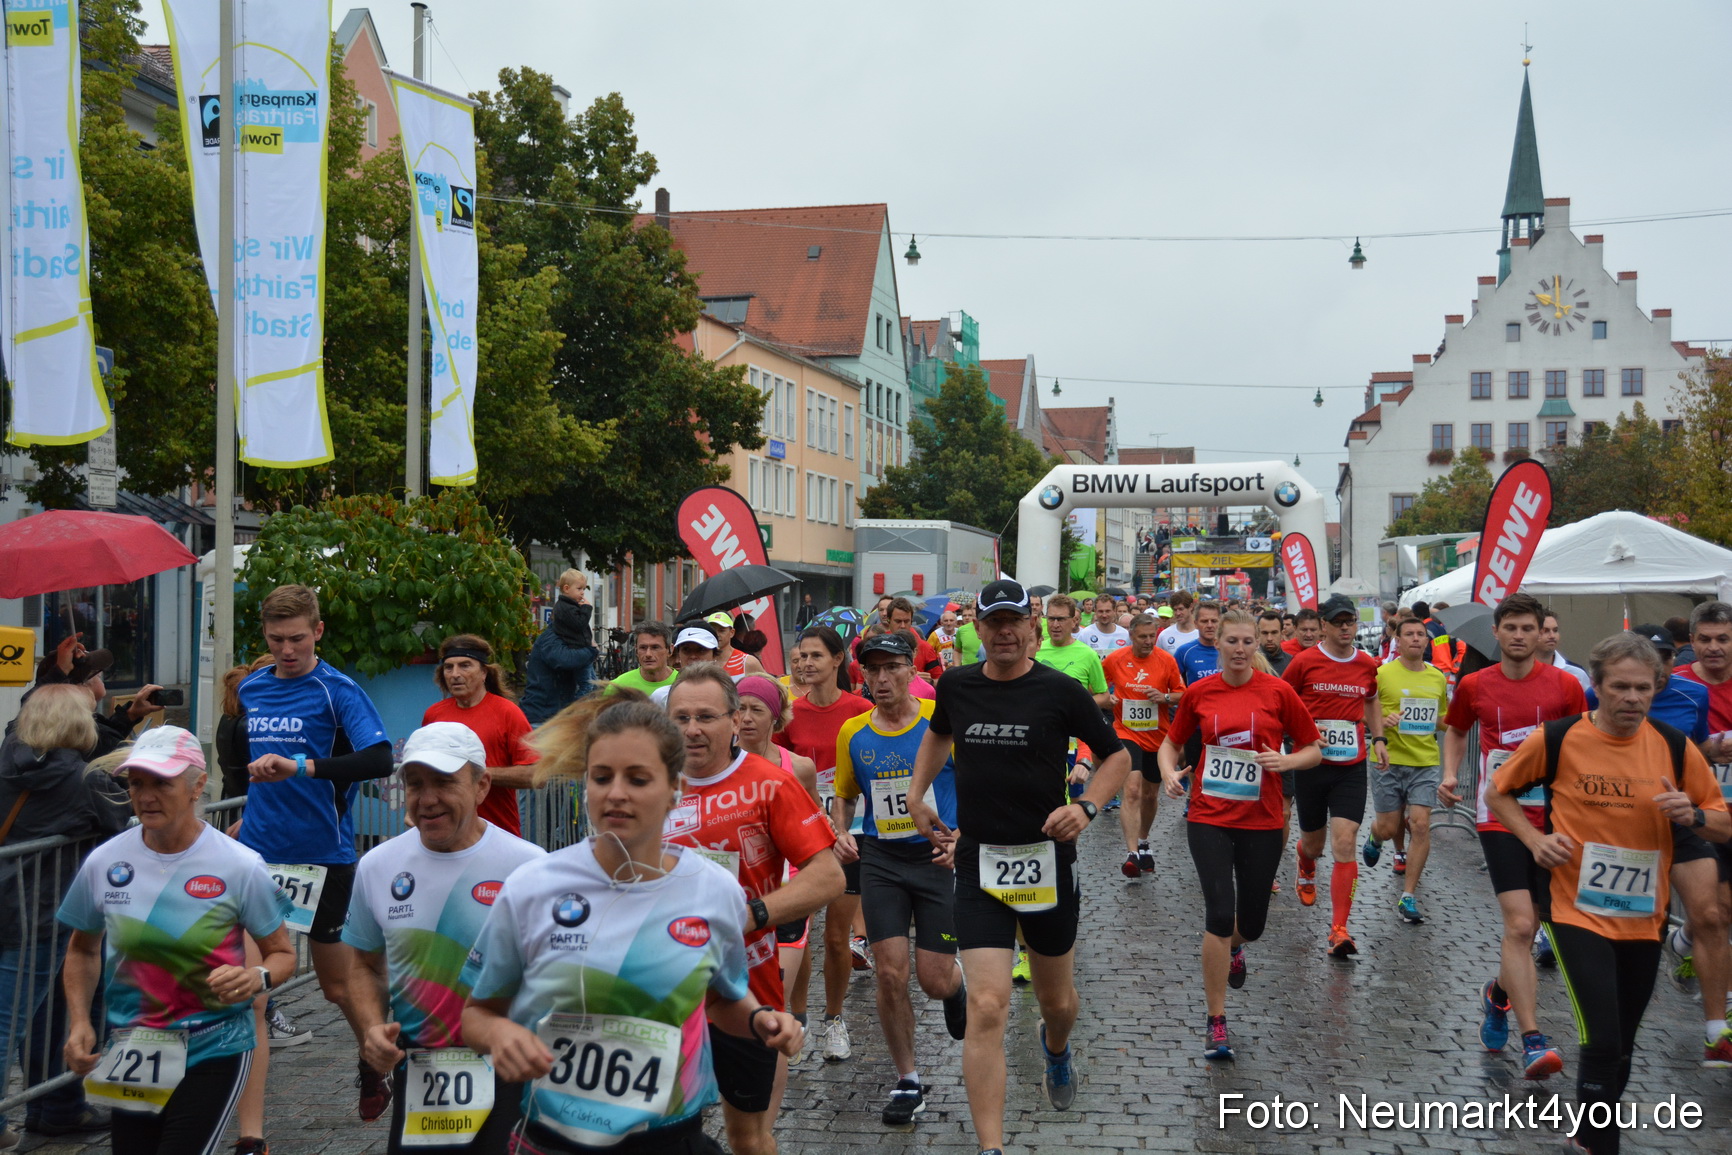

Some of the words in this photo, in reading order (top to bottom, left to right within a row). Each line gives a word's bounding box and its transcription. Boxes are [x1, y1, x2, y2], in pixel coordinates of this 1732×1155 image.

[1072, 473, 1138, 494] BMW
[1145, 472, 1265, 496] Laufsport
[1479, 481, 1542, 609] REWE
[1211, 556, 1234, 566] ZIEL
[1313, 682, 1359, 694] NEUMARKT
[1129, 707, 1152, 720] 330
[1404, 706, 1436, 721] 2037
[248, 716, 304, 733] SYSCAD
[965, 723, 1030, 738] ARZT
[964, 737, 1029, 746] www.arzt-reisen.de
[1326, 747, 1347, 757] Jürgen
[1210, 758, 1257, 783] 3078
[1583, 781, 1635, 798] OEXL
[883, 793, 909, 816] 15
[706, 808, 756, 827] schenken
[996, 859, 1042, 885] 223
[1588, 861, 1650, 893] 2771
[190, 881, 222, 893] Hervis
[105, 892, 131, 900] PARTL
[1001, 892, 1037, 902] Helmut
[1603, 896, 1632, 909] Franz
[388, 904, 414, 914] PARTL
[388, 912, 414, 921] Neumarkt
[551, 933, 589, 944] PARTL
[550, 943, 588, 951] Neumarkt
[602, 1018, 668, 1044] BOCK
[106, 1048, 162, 1083] 221
[550, 1037, 661, 1103] 3064
[122, 1087, 145, 1098] Eva
[422, 1071, 473, 1106] 220
[559, 1099, 614, 1131] Kristina
[421, 1116, 472, 1133] Christoph
